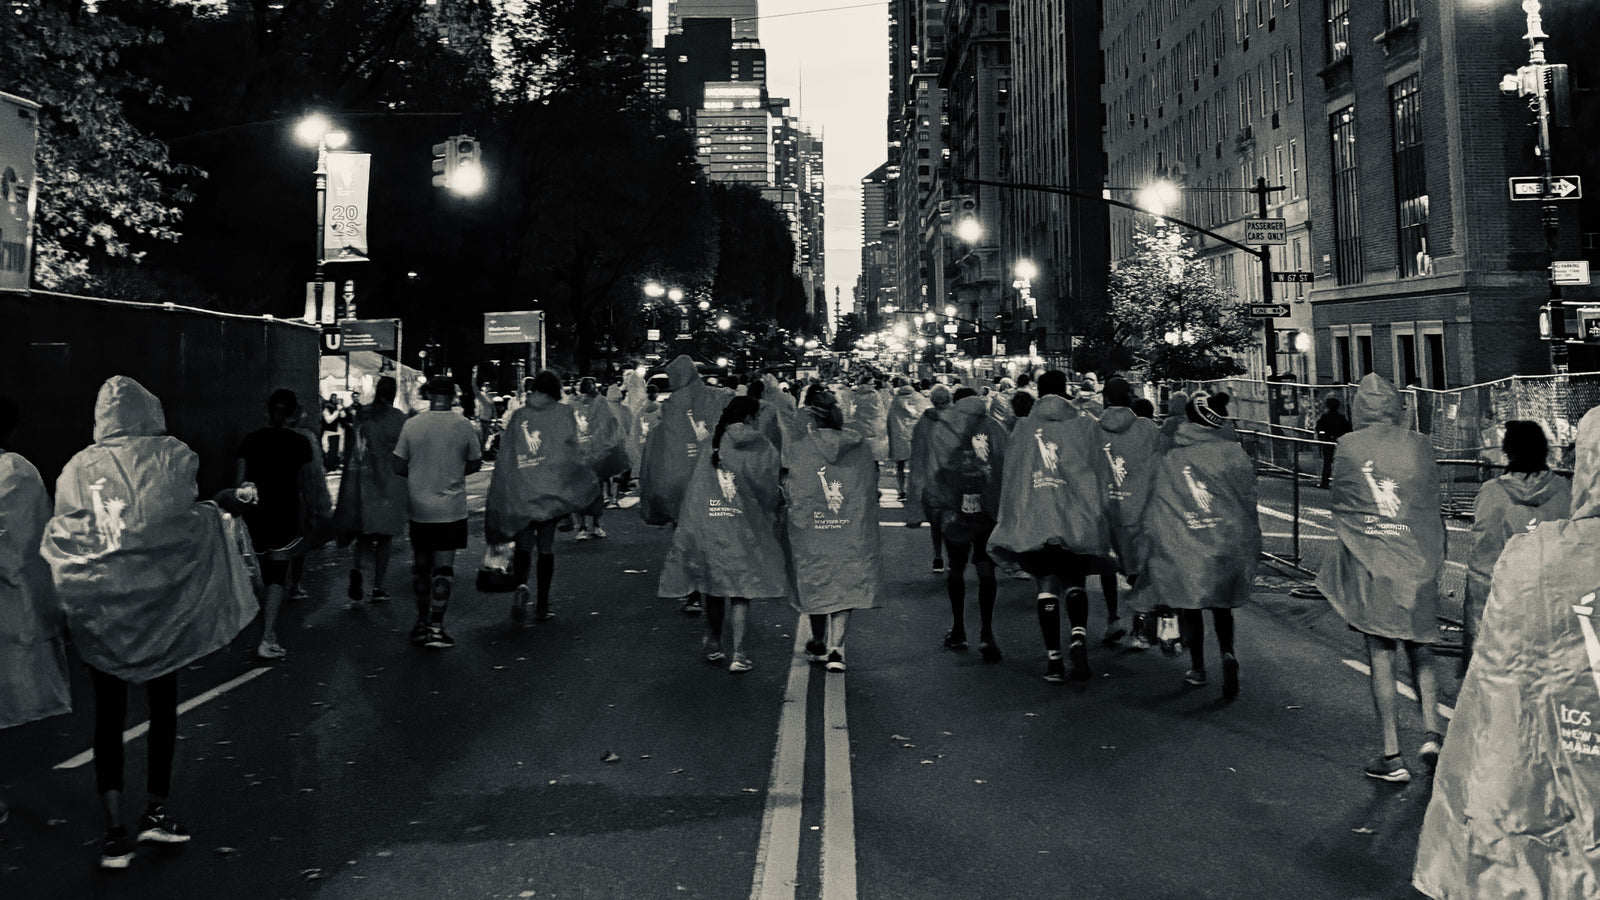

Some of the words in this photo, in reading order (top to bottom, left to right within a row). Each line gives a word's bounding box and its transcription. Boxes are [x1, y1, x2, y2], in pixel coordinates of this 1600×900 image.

[1521, 184, 1543, 193] ONE
[332, 204, 359, 221] 20
[1247, 222, 1284, 230] PASSENGER
[1247, 232, 1265, 240] CARS
[1267, 232, 1284, 240] ONLY
[1561, 704, 1592, 726] tcs
